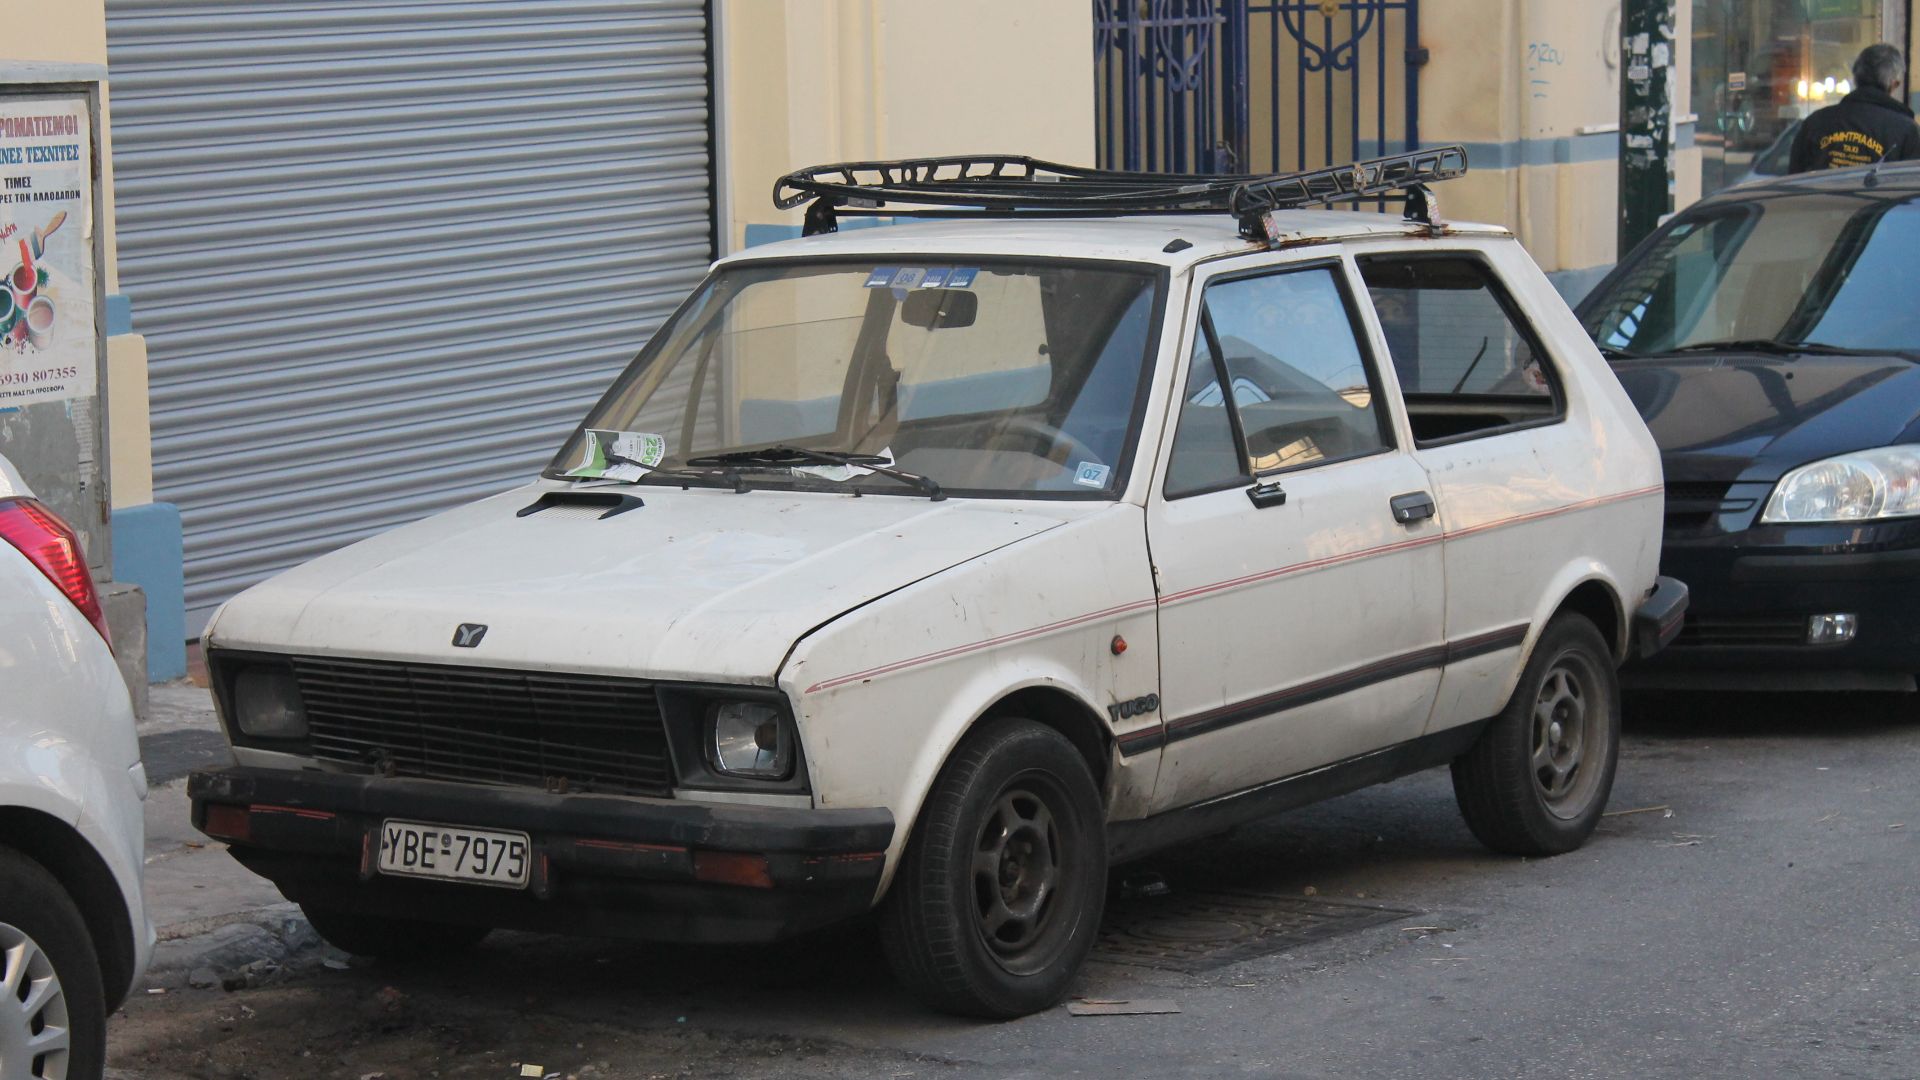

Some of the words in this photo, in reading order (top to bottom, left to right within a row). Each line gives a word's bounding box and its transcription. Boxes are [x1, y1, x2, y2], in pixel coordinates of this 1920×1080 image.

[26, 144, 79, 163] ΤΕΧΝΙΤΕΣ
[4, 176, 32, 189] ΤΙΜΕΣ
[15, 193, 31, 202] ΤΩΝ
[32, 366, 77, 382] 807355
[1083, 469, 1101, 480] 07
[1107, 693, 1159, 723] YUGO
